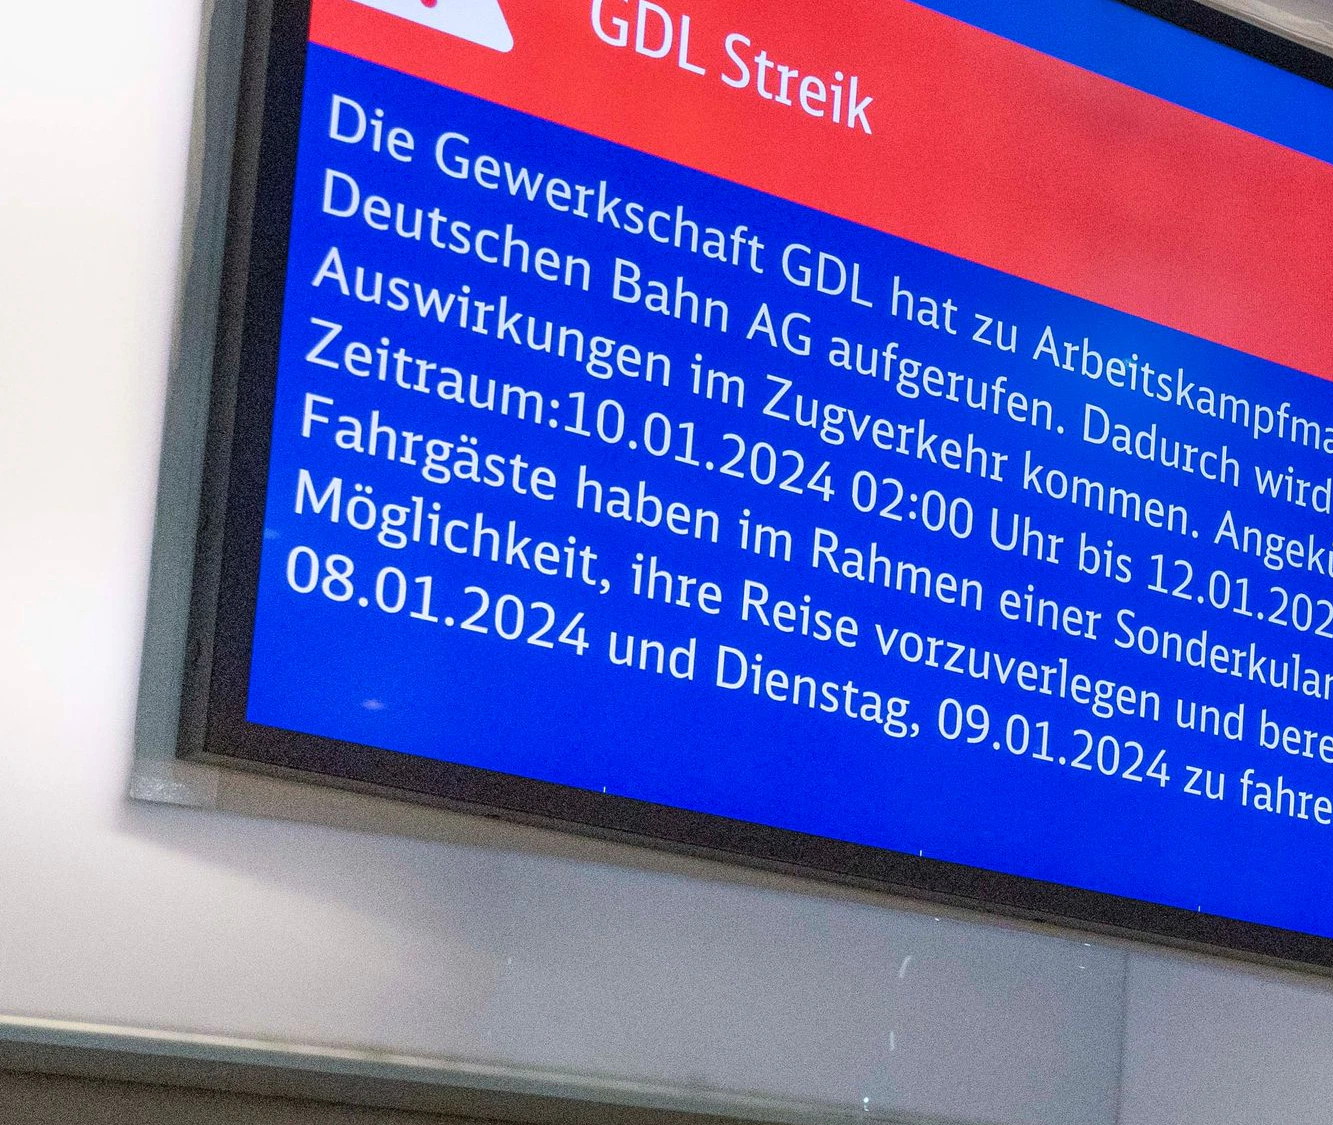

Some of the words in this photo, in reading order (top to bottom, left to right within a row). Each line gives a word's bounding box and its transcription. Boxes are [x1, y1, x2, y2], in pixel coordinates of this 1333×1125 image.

[590, 0, 707, 76] GDL
[720, 32, 874, 135] Streik
[322, 168, 591, 291] Deutschen
[612, 257, 728, 333] Bahn
[746, 303, 811, 356] AG
[828, 337, 1064, 434] aufgerufen.
[1083, 403, 1240, 487] Dadurch
[1255, 466, 1332, 514] wird
[329, 94, 415, 162] Die
[435, 132, 765, 274] Gewerkschaft
[782, 243, 873, 308] GDL
[891, 276, 958, 335] hat
[972, 313, 1017, 353] zu
[302, 392, 557, 501] Fahrgäste
[576, 465, 719, 543] haben
[739, 508, 792, 562] im
[812, 527, 983, 611] Rahmen
[1000, 584, 1102, 640] einer
[305, 317, 835, 502] Zeitraum:10.01.2024
[851, 470, 974, 539] 02:00
[990, 508, 1064, 564] Uhr
[1078, 532, 1132, 583] bis
[312, 246, 671, 387] Auswirkungen
[691, 353, 745, 408] im
[762, 374, 1009, 482] Zugverkehr
[1023, 450, 1199, 538] kommen.
[286, 545, 590, 656] 08.01.2024
[609, 631, 697, 681] und
[716, 644, 920, 738] Dienstag,
[938, 698, 1170, 787] 09.01.2024
[1183, 765, 1225, 800] zu
[294, 468, 610, 595] Möglichkeit,
[631, 552, 722, 615] ihre
[741, 579, 858, 648] Reise
[875, 624, 1160, 721] vorzuverlegen
[1176, 699, 1245, 741] und
